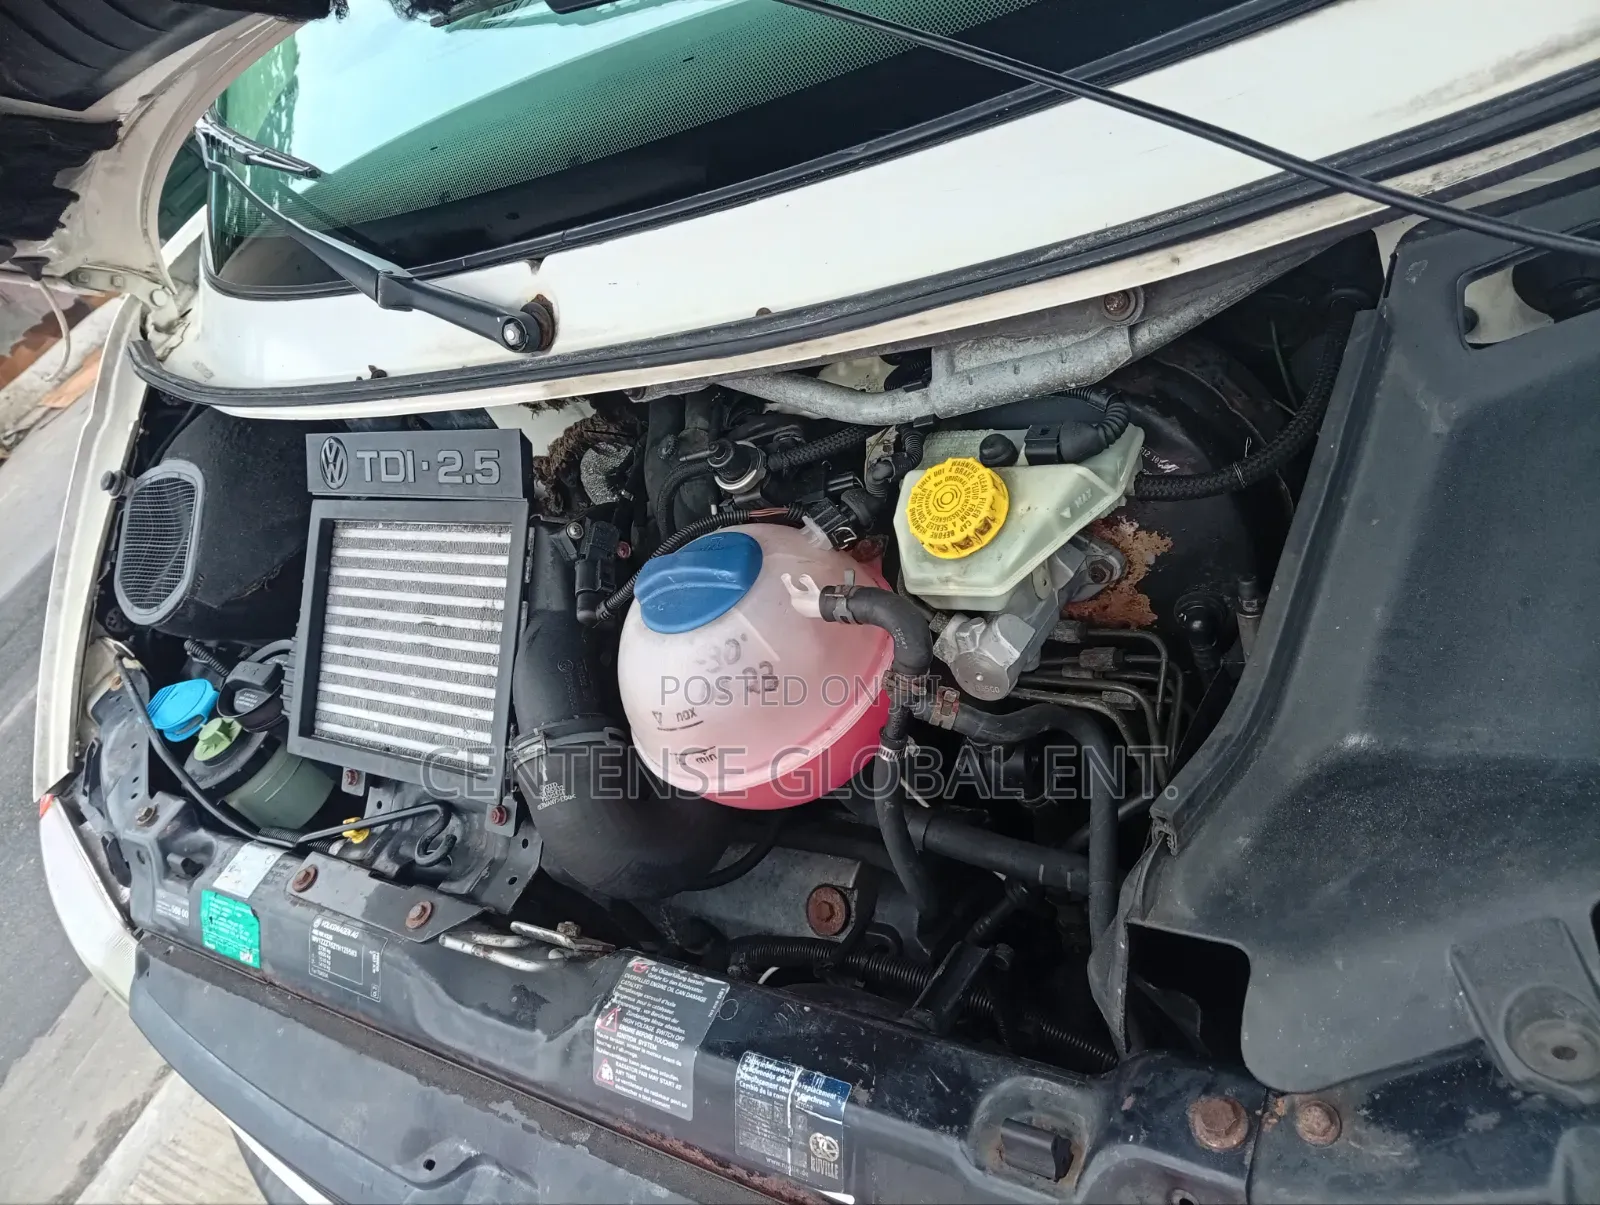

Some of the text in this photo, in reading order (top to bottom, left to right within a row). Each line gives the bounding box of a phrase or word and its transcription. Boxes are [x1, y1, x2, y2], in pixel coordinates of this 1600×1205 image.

[357, 450, 500, 484] TDI 2.5
[951, 461, 979, 473] WARNING
[954, 468, 975, 481] BRAKE
[977, 473, 988, 493] CLEAN
[960, 504, 976, 522] FROM
[971, 497, 986, 518] FILLER
[926, 520, 948, 531] SEALED
[960, 520, 972, 532] CAP
[929, 530, 955, 539] BEFORE
[321, 920, 351, 936] VOLKSWAGEN
[624, 973, 650, 984] OVERFILLED
[650, 981, 666, 990] ENGINE
[686, 993, 706, 1002] DAMAGE
[619, 1024, 679, 1049] ENGINE BEFORE TOUCHING
[655, 1029, 674, 1038] SWITCH
[810, 1156, 839, 1179] RUVILLE
